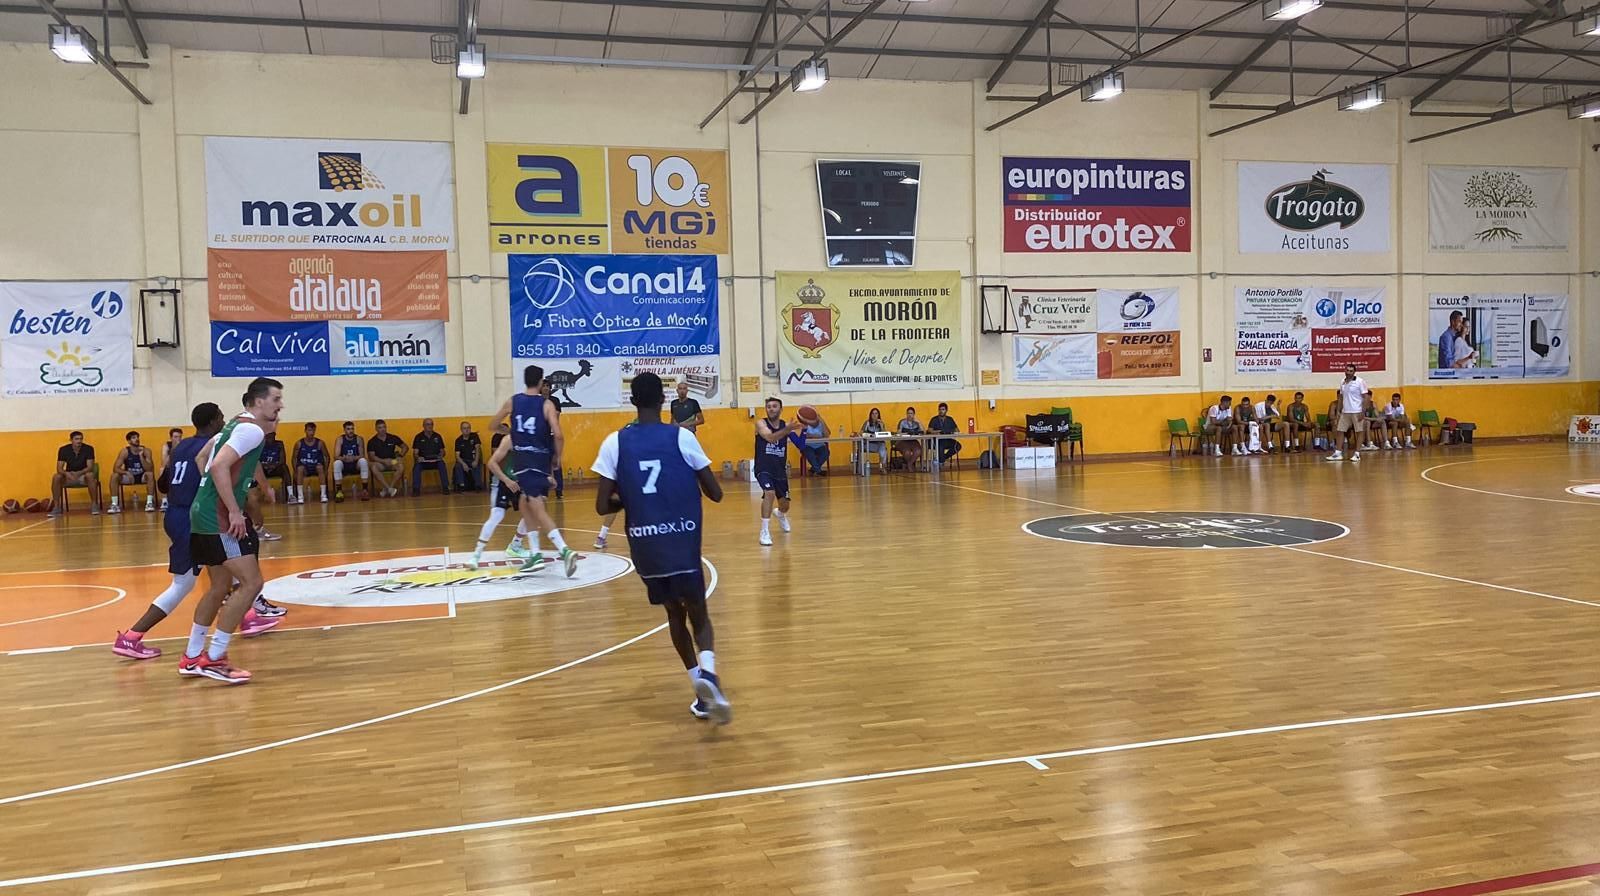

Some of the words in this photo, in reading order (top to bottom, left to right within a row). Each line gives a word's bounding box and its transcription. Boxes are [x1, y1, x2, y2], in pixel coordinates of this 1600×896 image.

[1008, 162, 1185, 195] europinturas
[515, 155, 582, 217] a
[242, 194, 422, 228] maxoil
[1272, 186, 1357, 223] Fragata
[1015, 208, 1102, 221] Distribuidor
[1475, 210, 1487, 219] LA
[1489, 210, 1527, 219] MORONA
[214, 234, 229, 243] EL
[230, 234, 285, 243] SURTIDOR
[287, 234, 310, 244] QUE
[312, 235, 371, 244] PATROCINA
[372, 235, 386, 244] AL
[389, 235, 409, 244] C.B.
[412, 233, 449, 244] MORÓN
[498, 233, 601, 246] arrones
[1025, 218, 1176, 249] eurotex
[645, 236, 697, 250] tiendas
[1281, 234, 1349, 250] Aceitunas
[289, 254, 334, 277] agenda
[218, 271, 243, 279] cultura
[415, 271, 438, 280] edición
[289, 274, 382, 320] atalaya
[418, 293, 439, 301] diseño
[940, 288, 951, 296] DE
[1245, 288, 1276, 297] Antonio
[1277, 288, 1303, 297] Portillo
[218, 303, 255, 311] formación
[632, 296, 706, 305] Comunicaciones
[1344, 298, 1382, 315] Placo
[1437, 297, 1460, 306] KOLUX
[406, 303, 440, 312] publicidad
[864, 298, 937, 322] MORÓN
[1033, 303, 1059, 314] Cruz
[1061, 303, 1091, 314] Verde
[9, 308, 93, 335] besten
[524, 314, 542, 328] La
[548, 313, 586, 328] Fibra
[593, 311, 640, 331] Óptica
[646, 312, 662, 326] de
[668, 312, 708, 326] Morón
[850, 328, 866, 341] DE
[871, 328, 886, 341] LA
[892, 327, 950, 340] FRONTERA
[1121, 334, 1173, 345] REPSOL
[1315, 334, 1350, 344] Medina
[1351, 334, 1382, 344] Torres
[216, 328, 262, 354] Cal
[345, 332, 431, 358] alumán
[1238, 340, 1268, 349] ISMAEL
[1269, 337, 1298, 349] GARCÍA
[518, 345, 543, 356] 955
[547, 345, 570, 356] 851
[576, 344, 600, 355] 840
[613, 343, 714, 355] canal4moron.es
[633, 357, 676, 366] COMERCIAL
[842, 349, 877, 373] ¡Vive
[883, 348, 897, 364] el
[899, 347, 952, 369] Deporte!
[834, 376, 872, 384] PATRONATO
[875, 375, 911, 383] MUNICIPAL
[913, 375, 922, 383] DE
[925, 374, 958, 383] DEPORTES
[515, 414, 537, 435] 14
[171, 460, 188, 485] 11
[639, 459, 661, 495] 7
